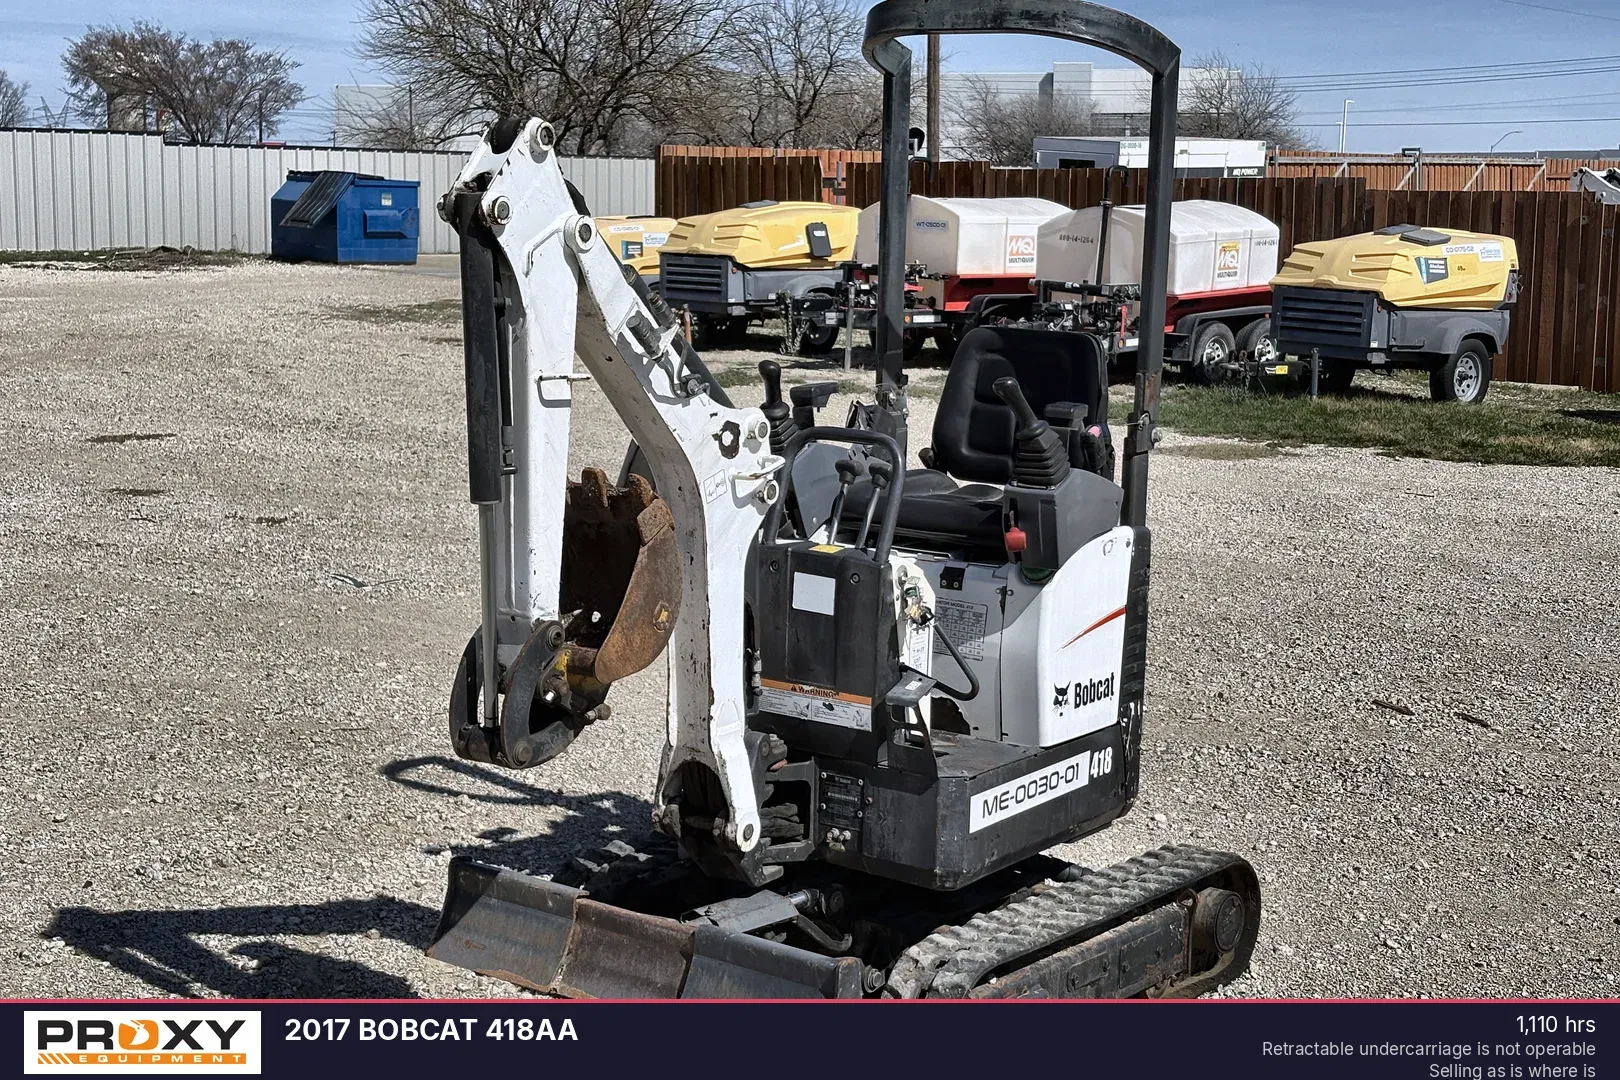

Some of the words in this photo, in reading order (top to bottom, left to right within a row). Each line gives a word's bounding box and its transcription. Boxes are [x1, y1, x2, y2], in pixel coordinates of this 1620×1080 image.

[1241, 168, 1259, 176] POWER
[1009, 236, 1035, 255] MQ
[1073, 672, 1115, 710] Bobcat
[1089, 746, 1113, 779] 418
[982, 762, 1080, 819] ME-0030-01
